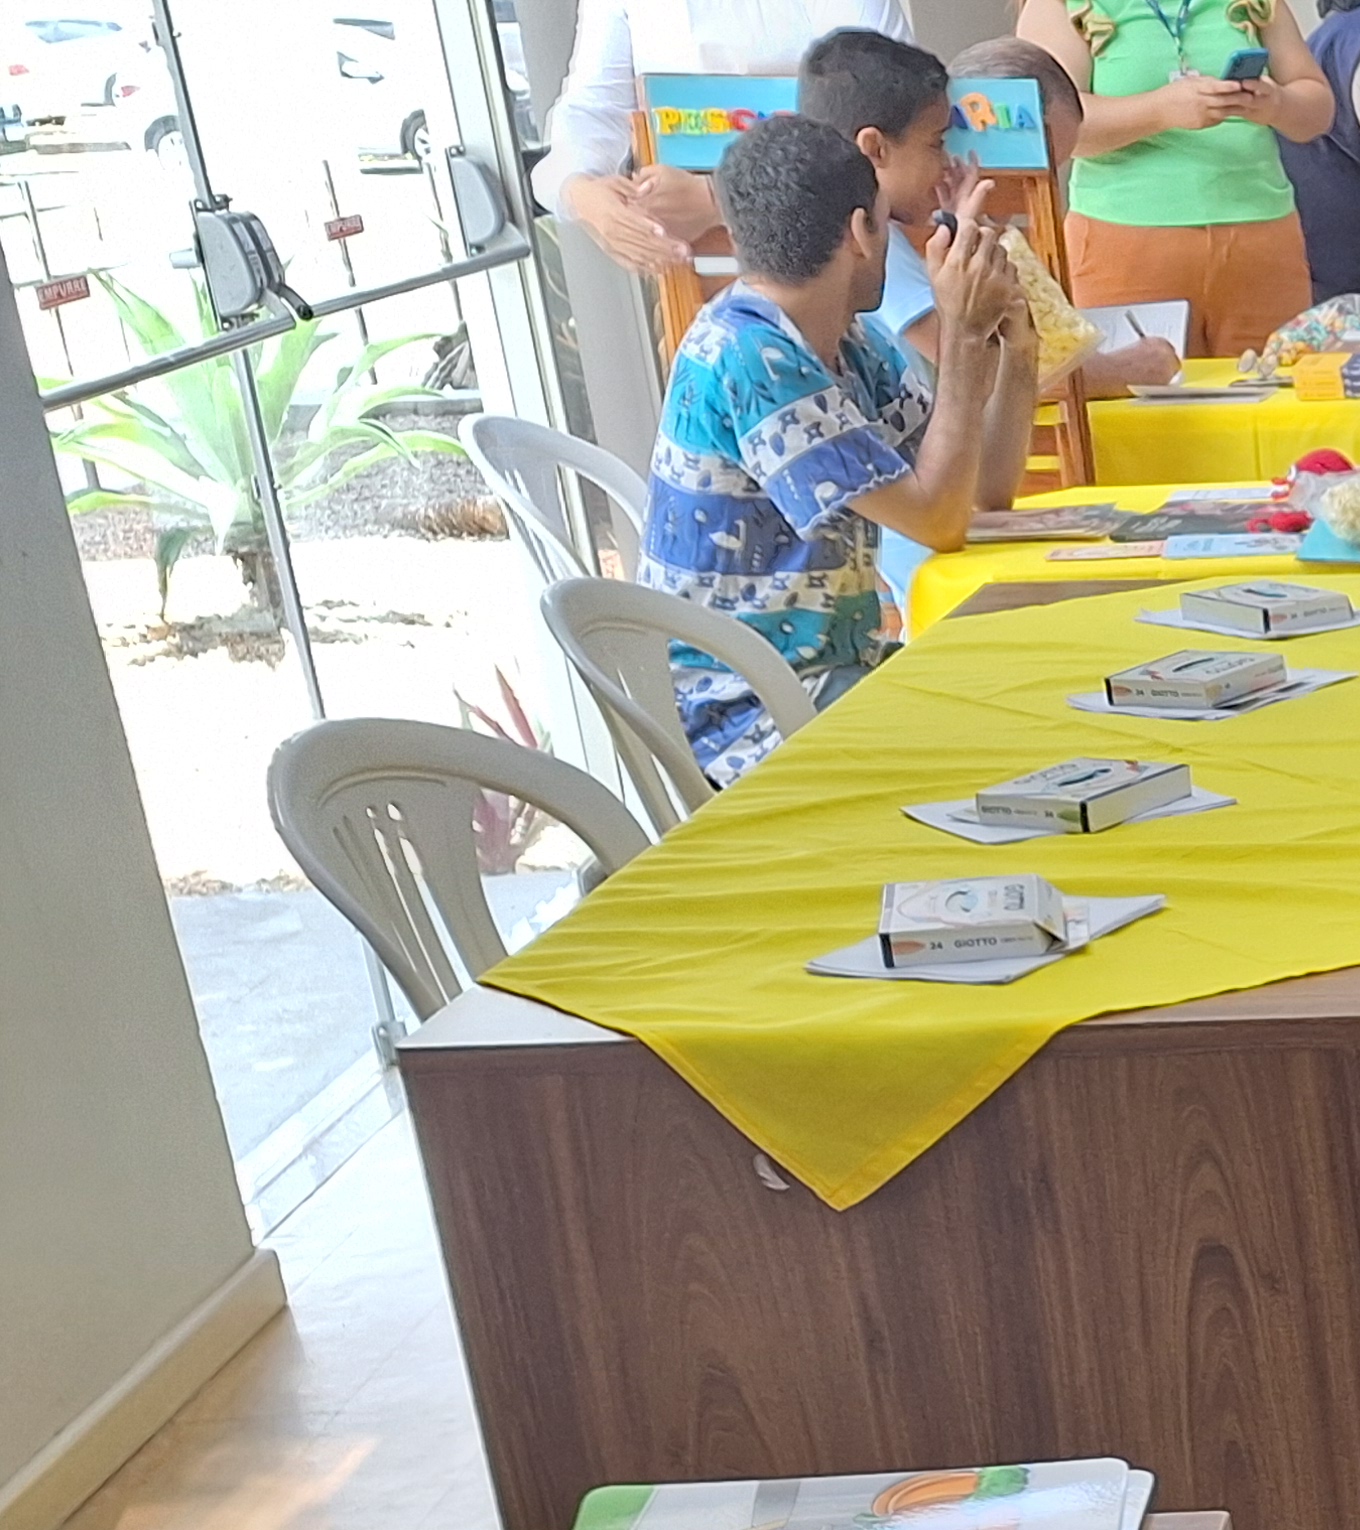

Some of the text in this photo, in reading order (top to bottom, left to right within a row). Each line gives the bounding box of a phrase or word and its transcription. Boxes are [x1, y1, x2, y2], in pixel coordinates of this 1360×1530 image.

[948, 92, 1037, 132] ARIA
[929, 941, 943, 950] 24
[953, 936, 998, 949] GIOTTO
